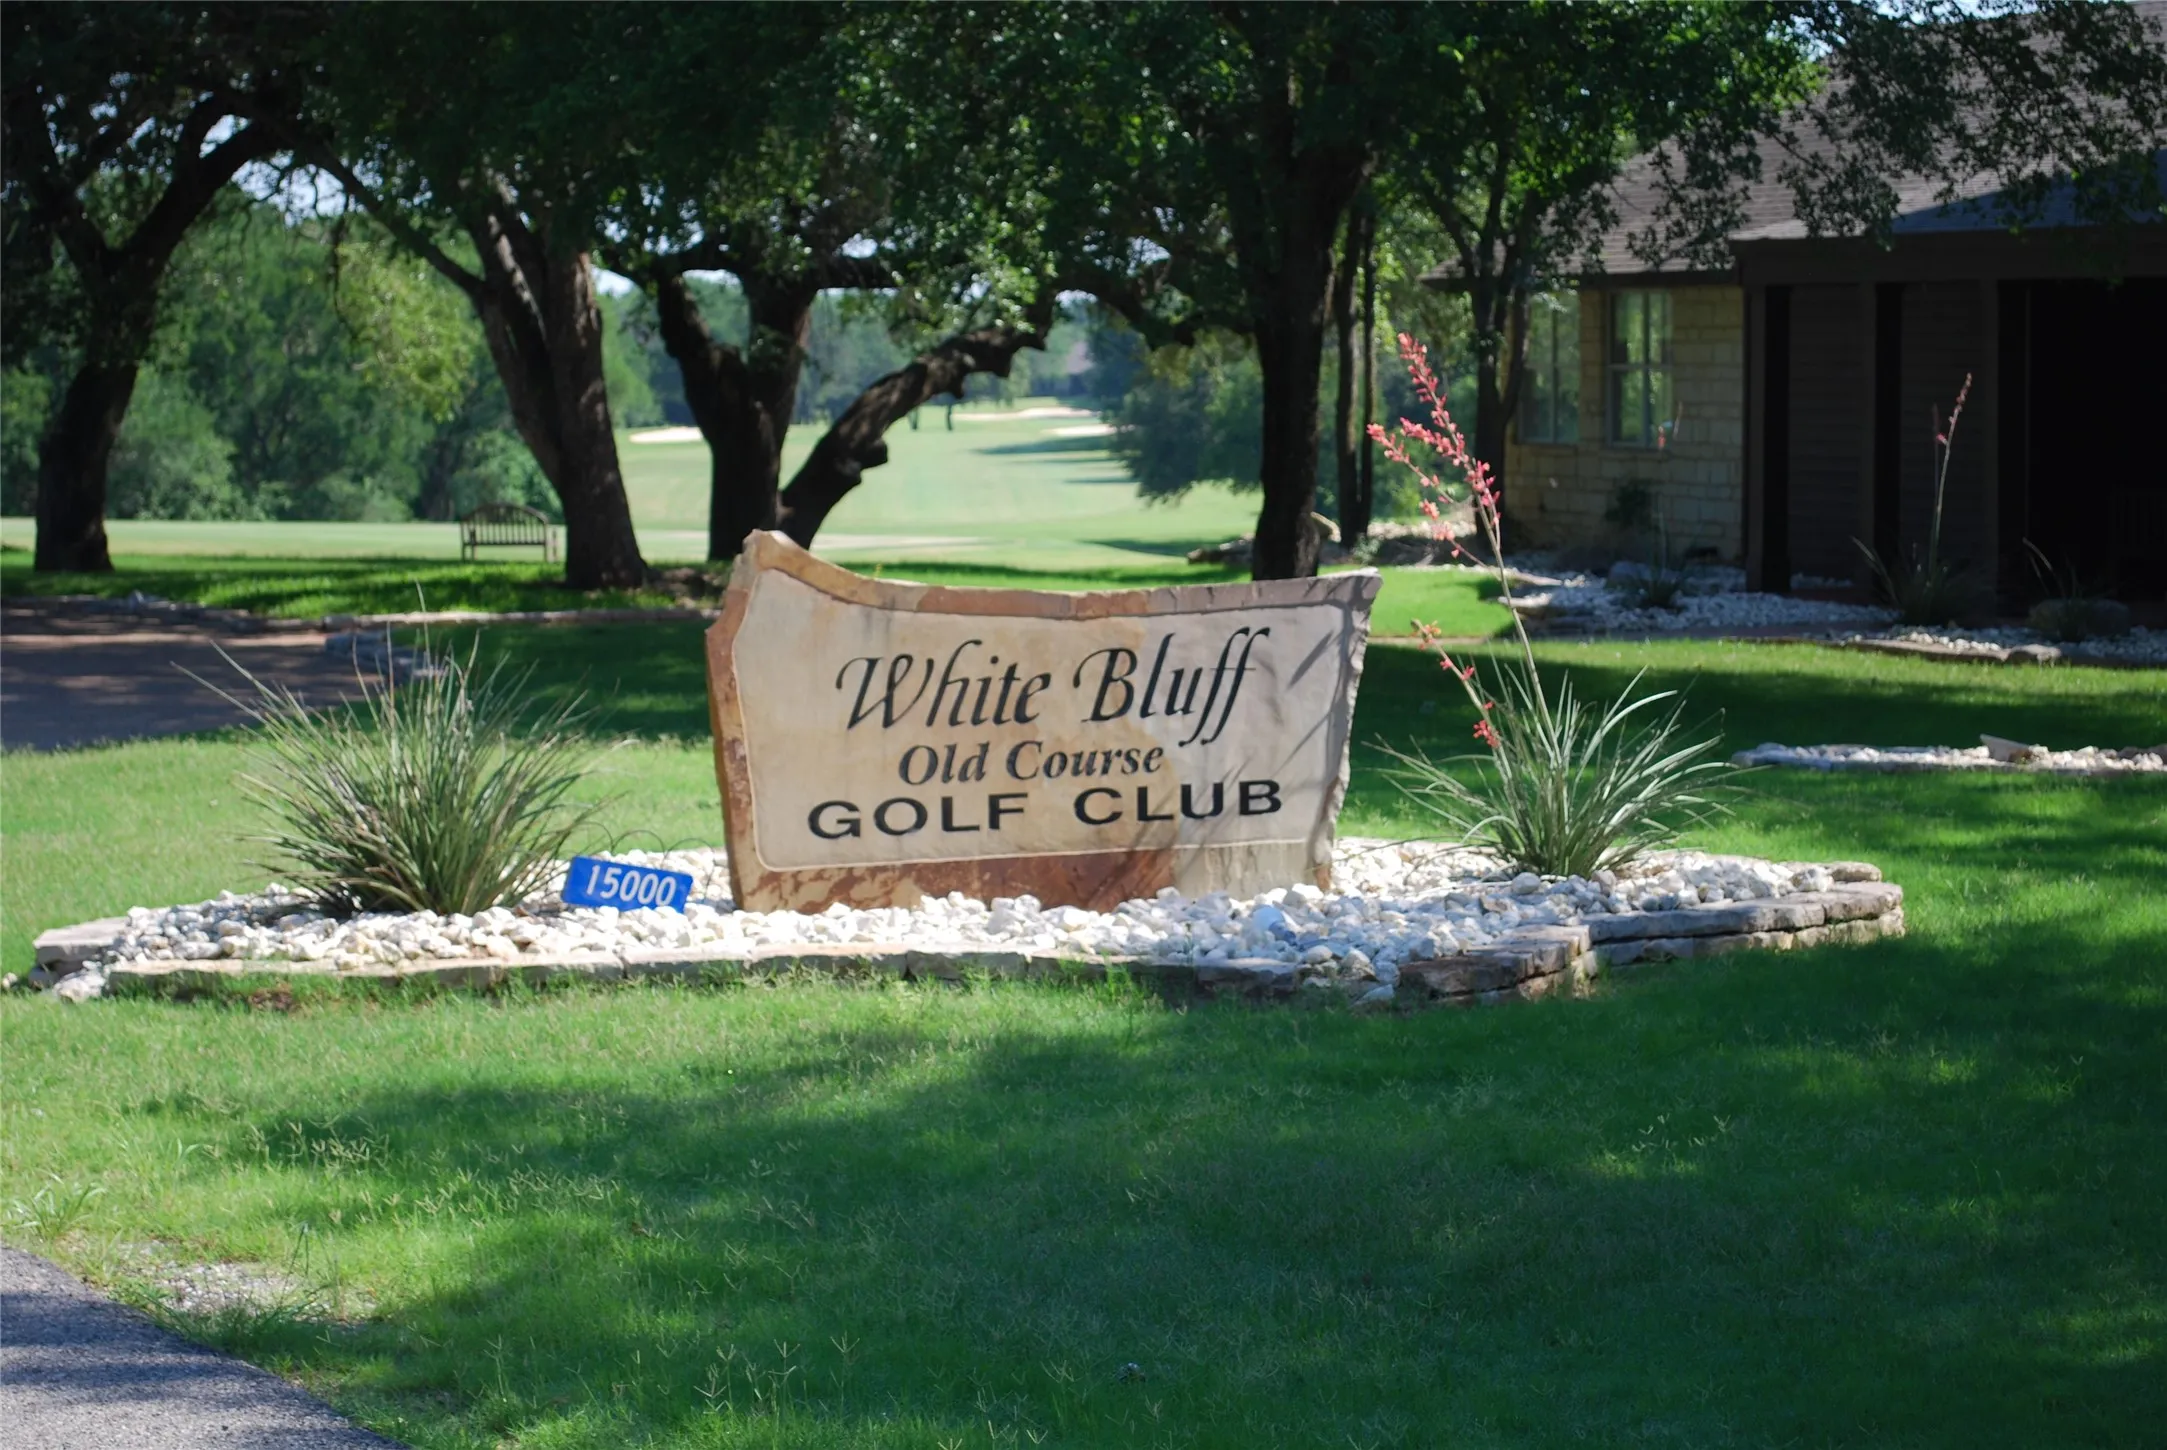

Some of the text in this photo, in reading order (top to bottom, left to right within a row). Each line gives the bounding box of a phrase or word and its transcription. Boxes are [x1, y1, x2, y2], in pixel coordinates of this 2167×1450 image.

[835, 627, 1271, 747] White Bluff
[898, 739, 1165, 786] Old Course
[807, 779, 1283, 839] GOLF CLUB
[586, 864, 677, 907] 15000
